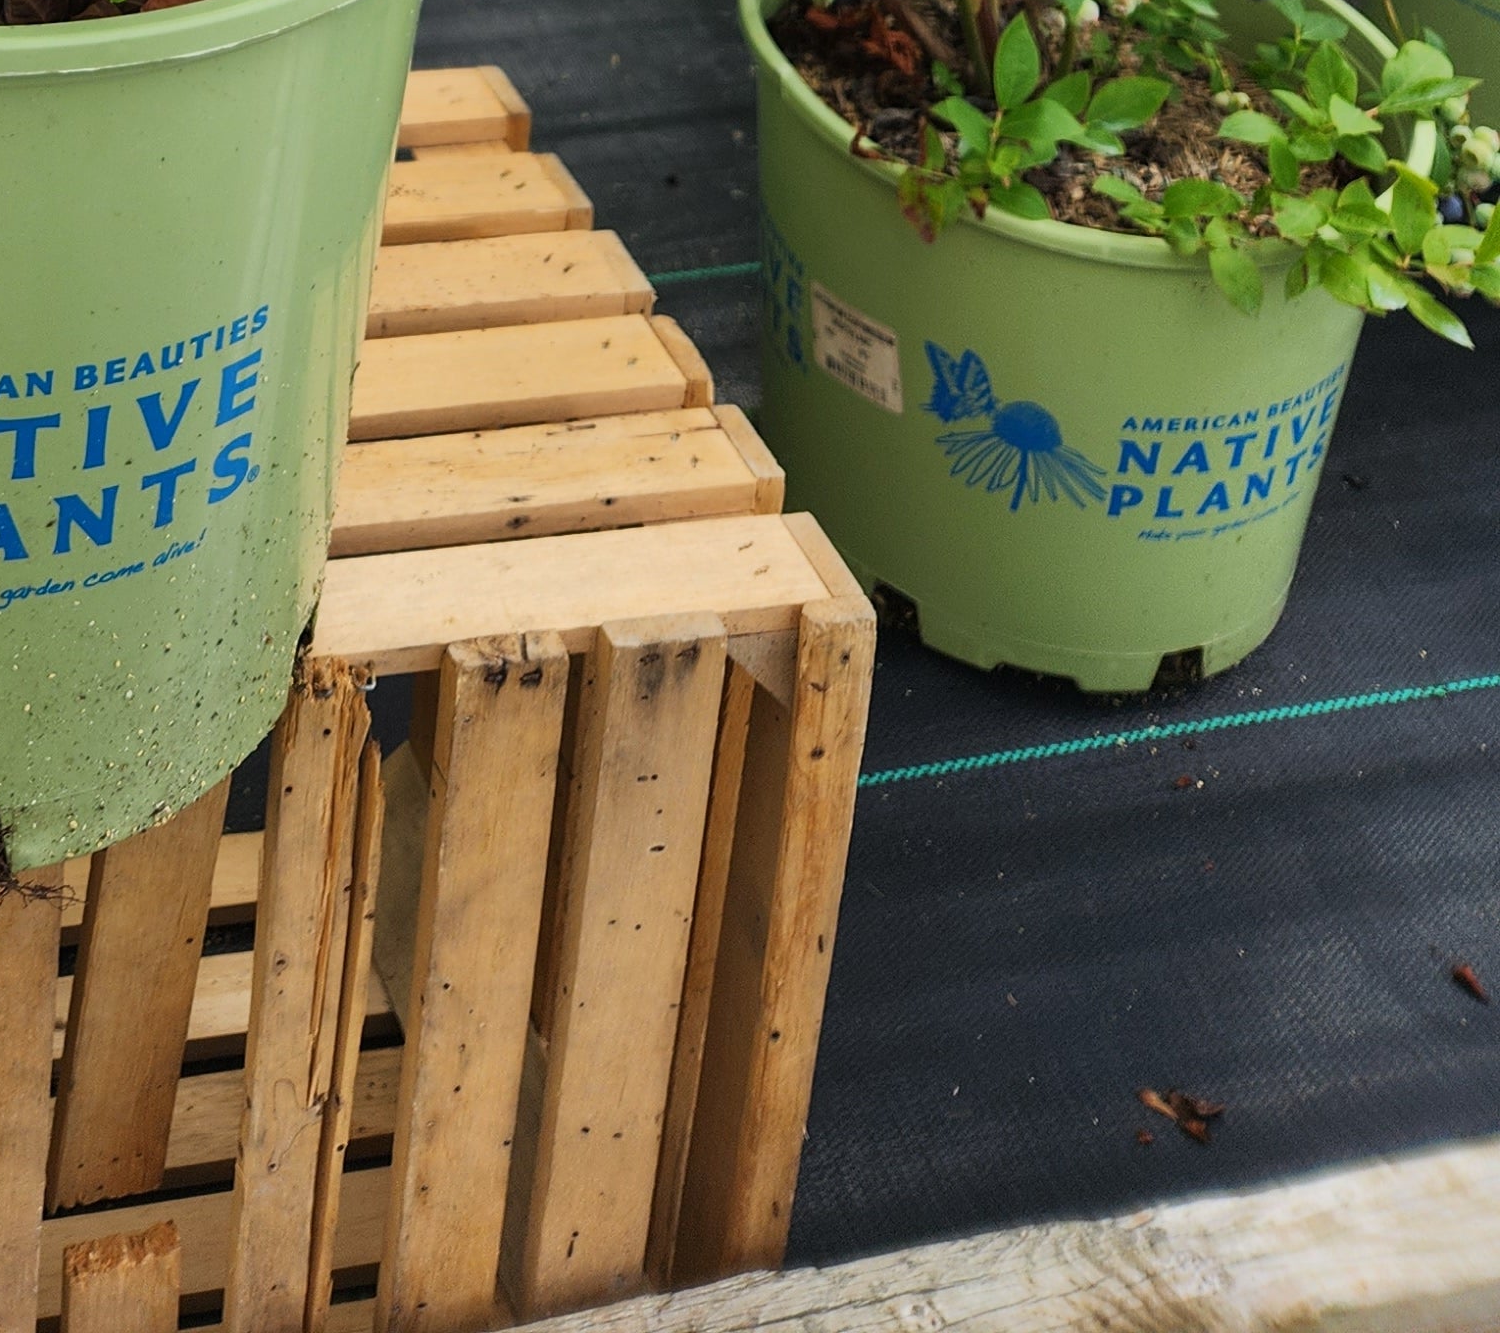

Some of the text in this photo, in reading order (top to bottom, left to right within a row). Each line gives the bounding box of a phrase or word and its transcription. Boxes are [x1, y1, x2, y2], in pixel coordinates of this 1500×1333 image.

[73, 304, 270, 391] BEAUTIES
[1117, 386, 1338, 476] NATIVE
[1121, 409, 1259, 433] AMERICAN
[1107, 431, 1326, 518] PLANTS
[83, 559, 145, 589] come
[151, 527, 208, 569] alive!
